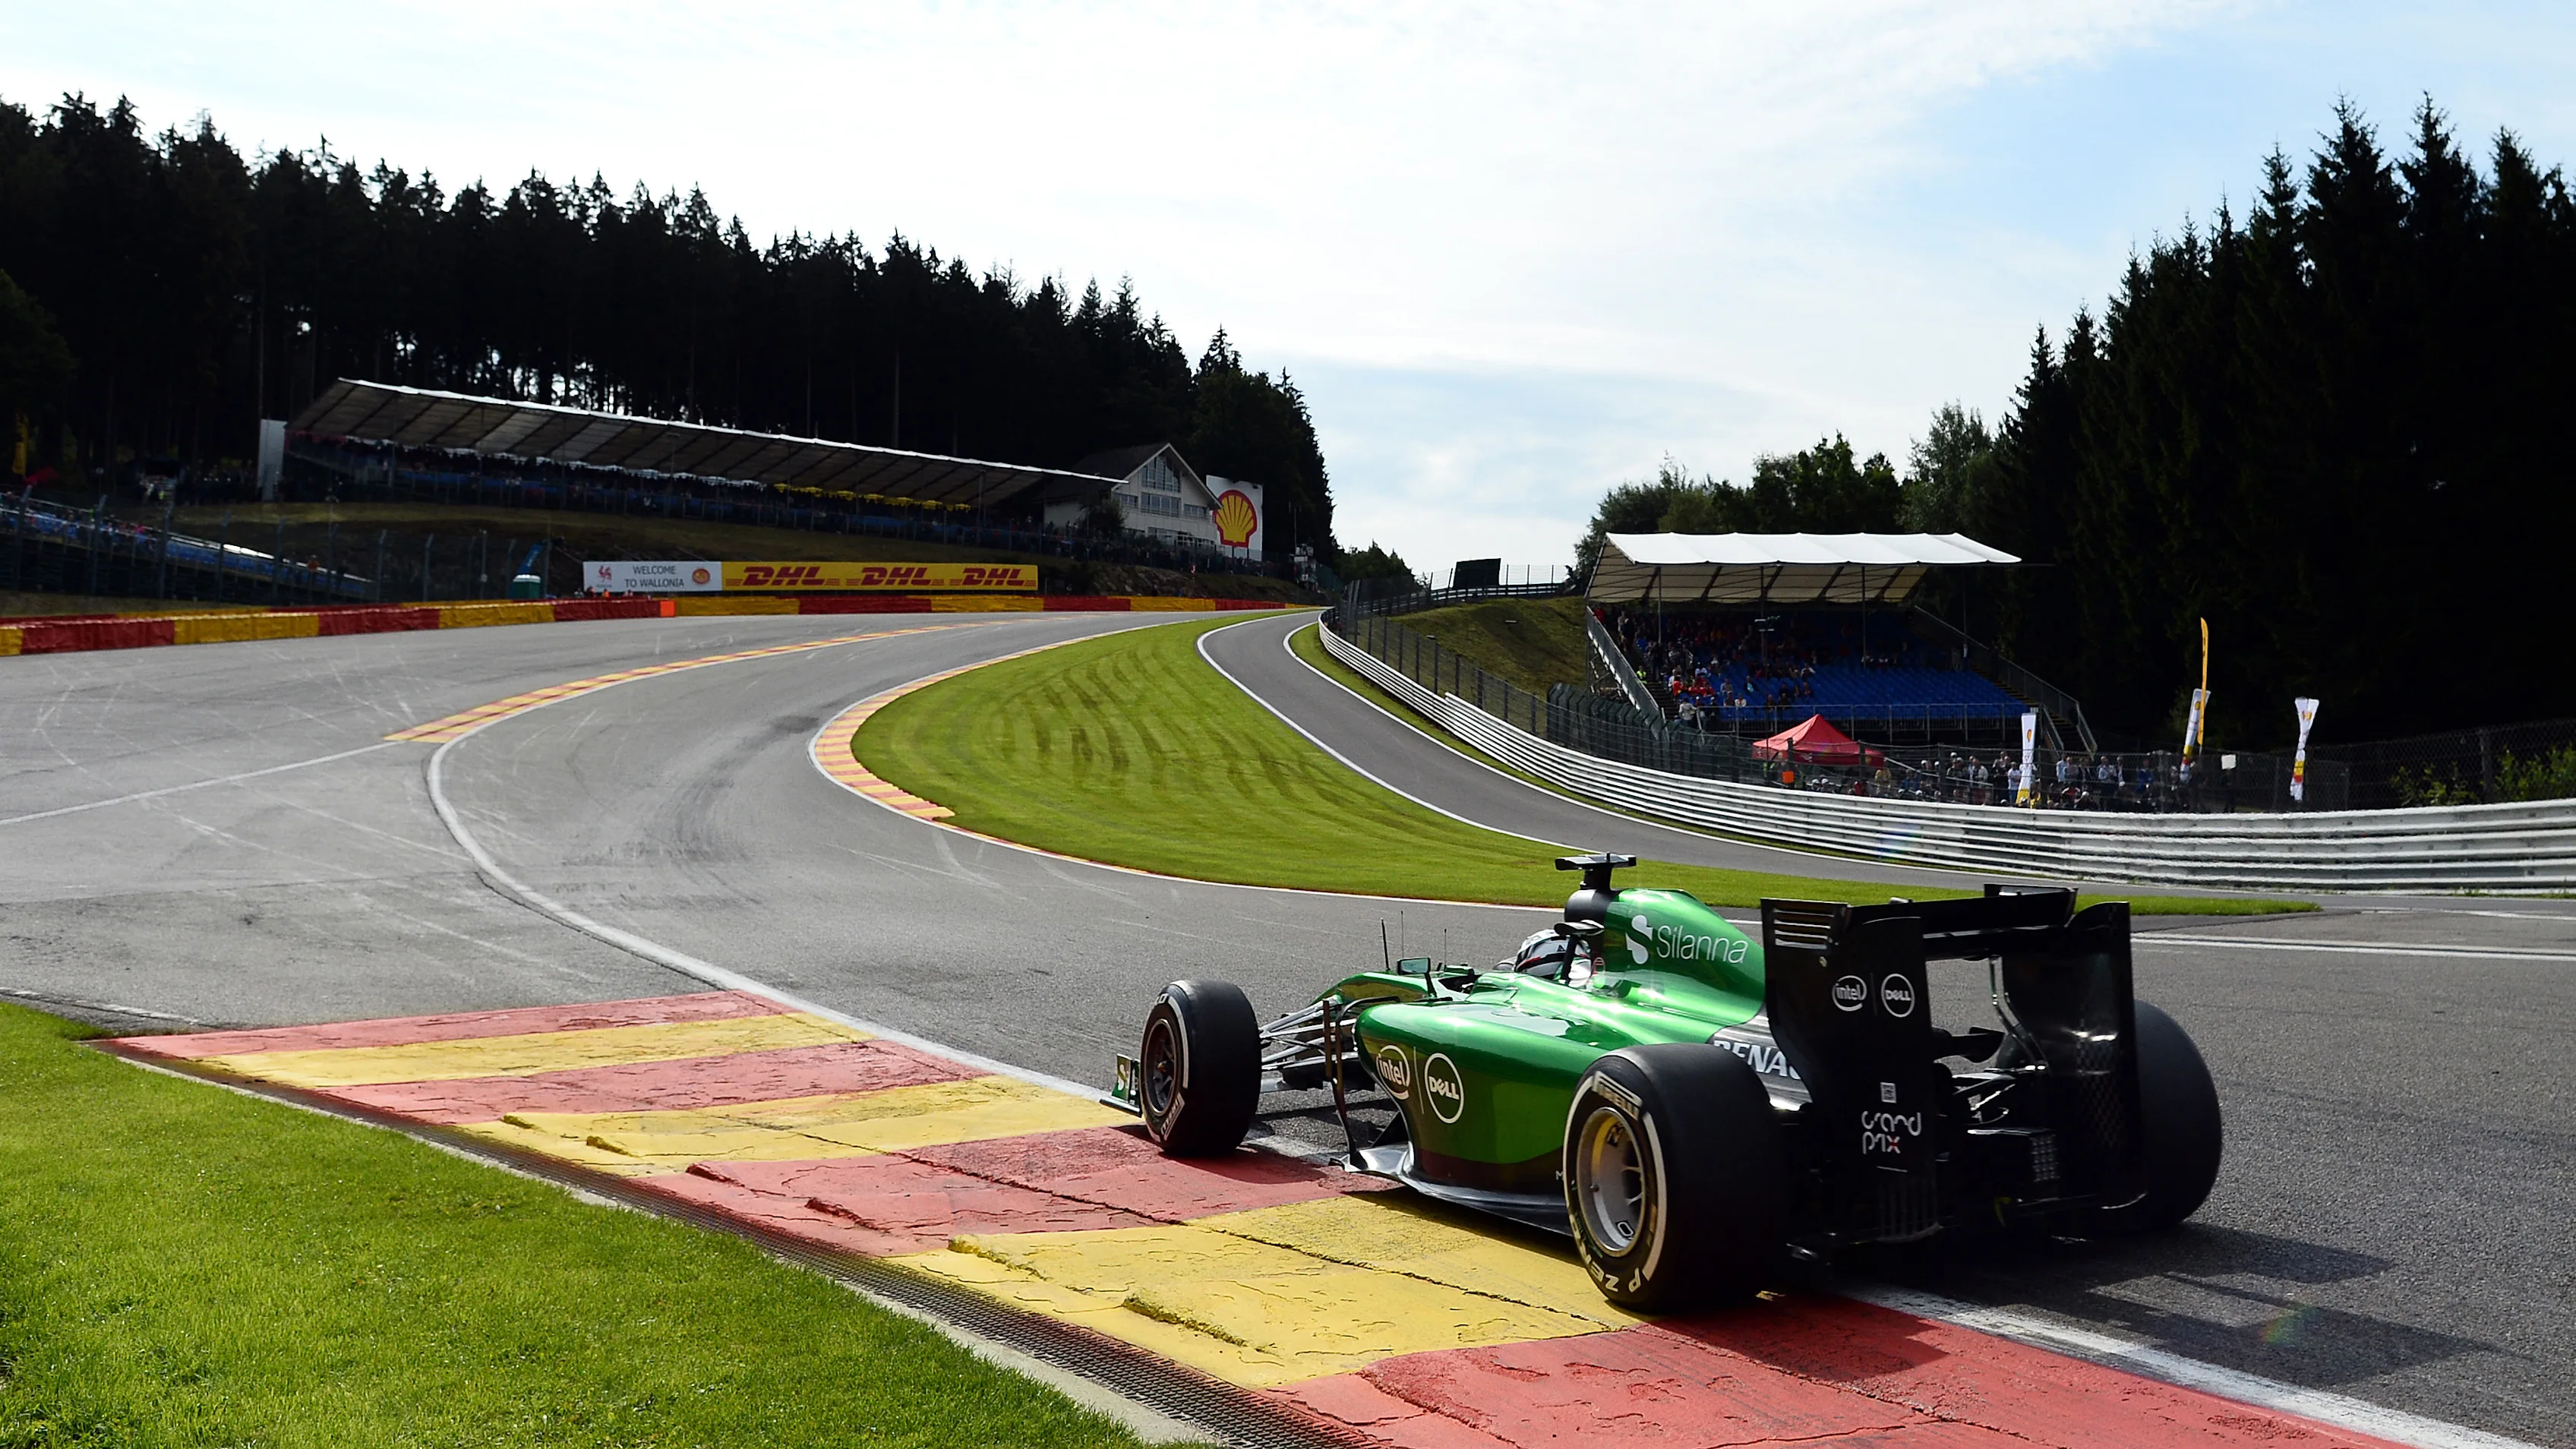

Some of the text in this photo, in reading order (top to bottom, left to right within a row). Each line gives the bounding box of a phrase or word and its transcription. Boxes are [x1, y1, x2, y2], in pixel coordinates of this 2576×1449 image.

[633, 565, 676, 575] WELCOME
[742, 566, 1024, 586] DHL DHL DHL
[625, 578, 684, 588] TO WALLONIA
[1656, 924, 1749, 964] Silanna
[1835, 983, 1864, 1001] intel
[1885, 990, 1911, 1001] DELL
[1378, 1053, 1409, 1087] intel
[1428, 1075, 1460, 1100] DELL
[1628, 1267, 1641, 1293] P
